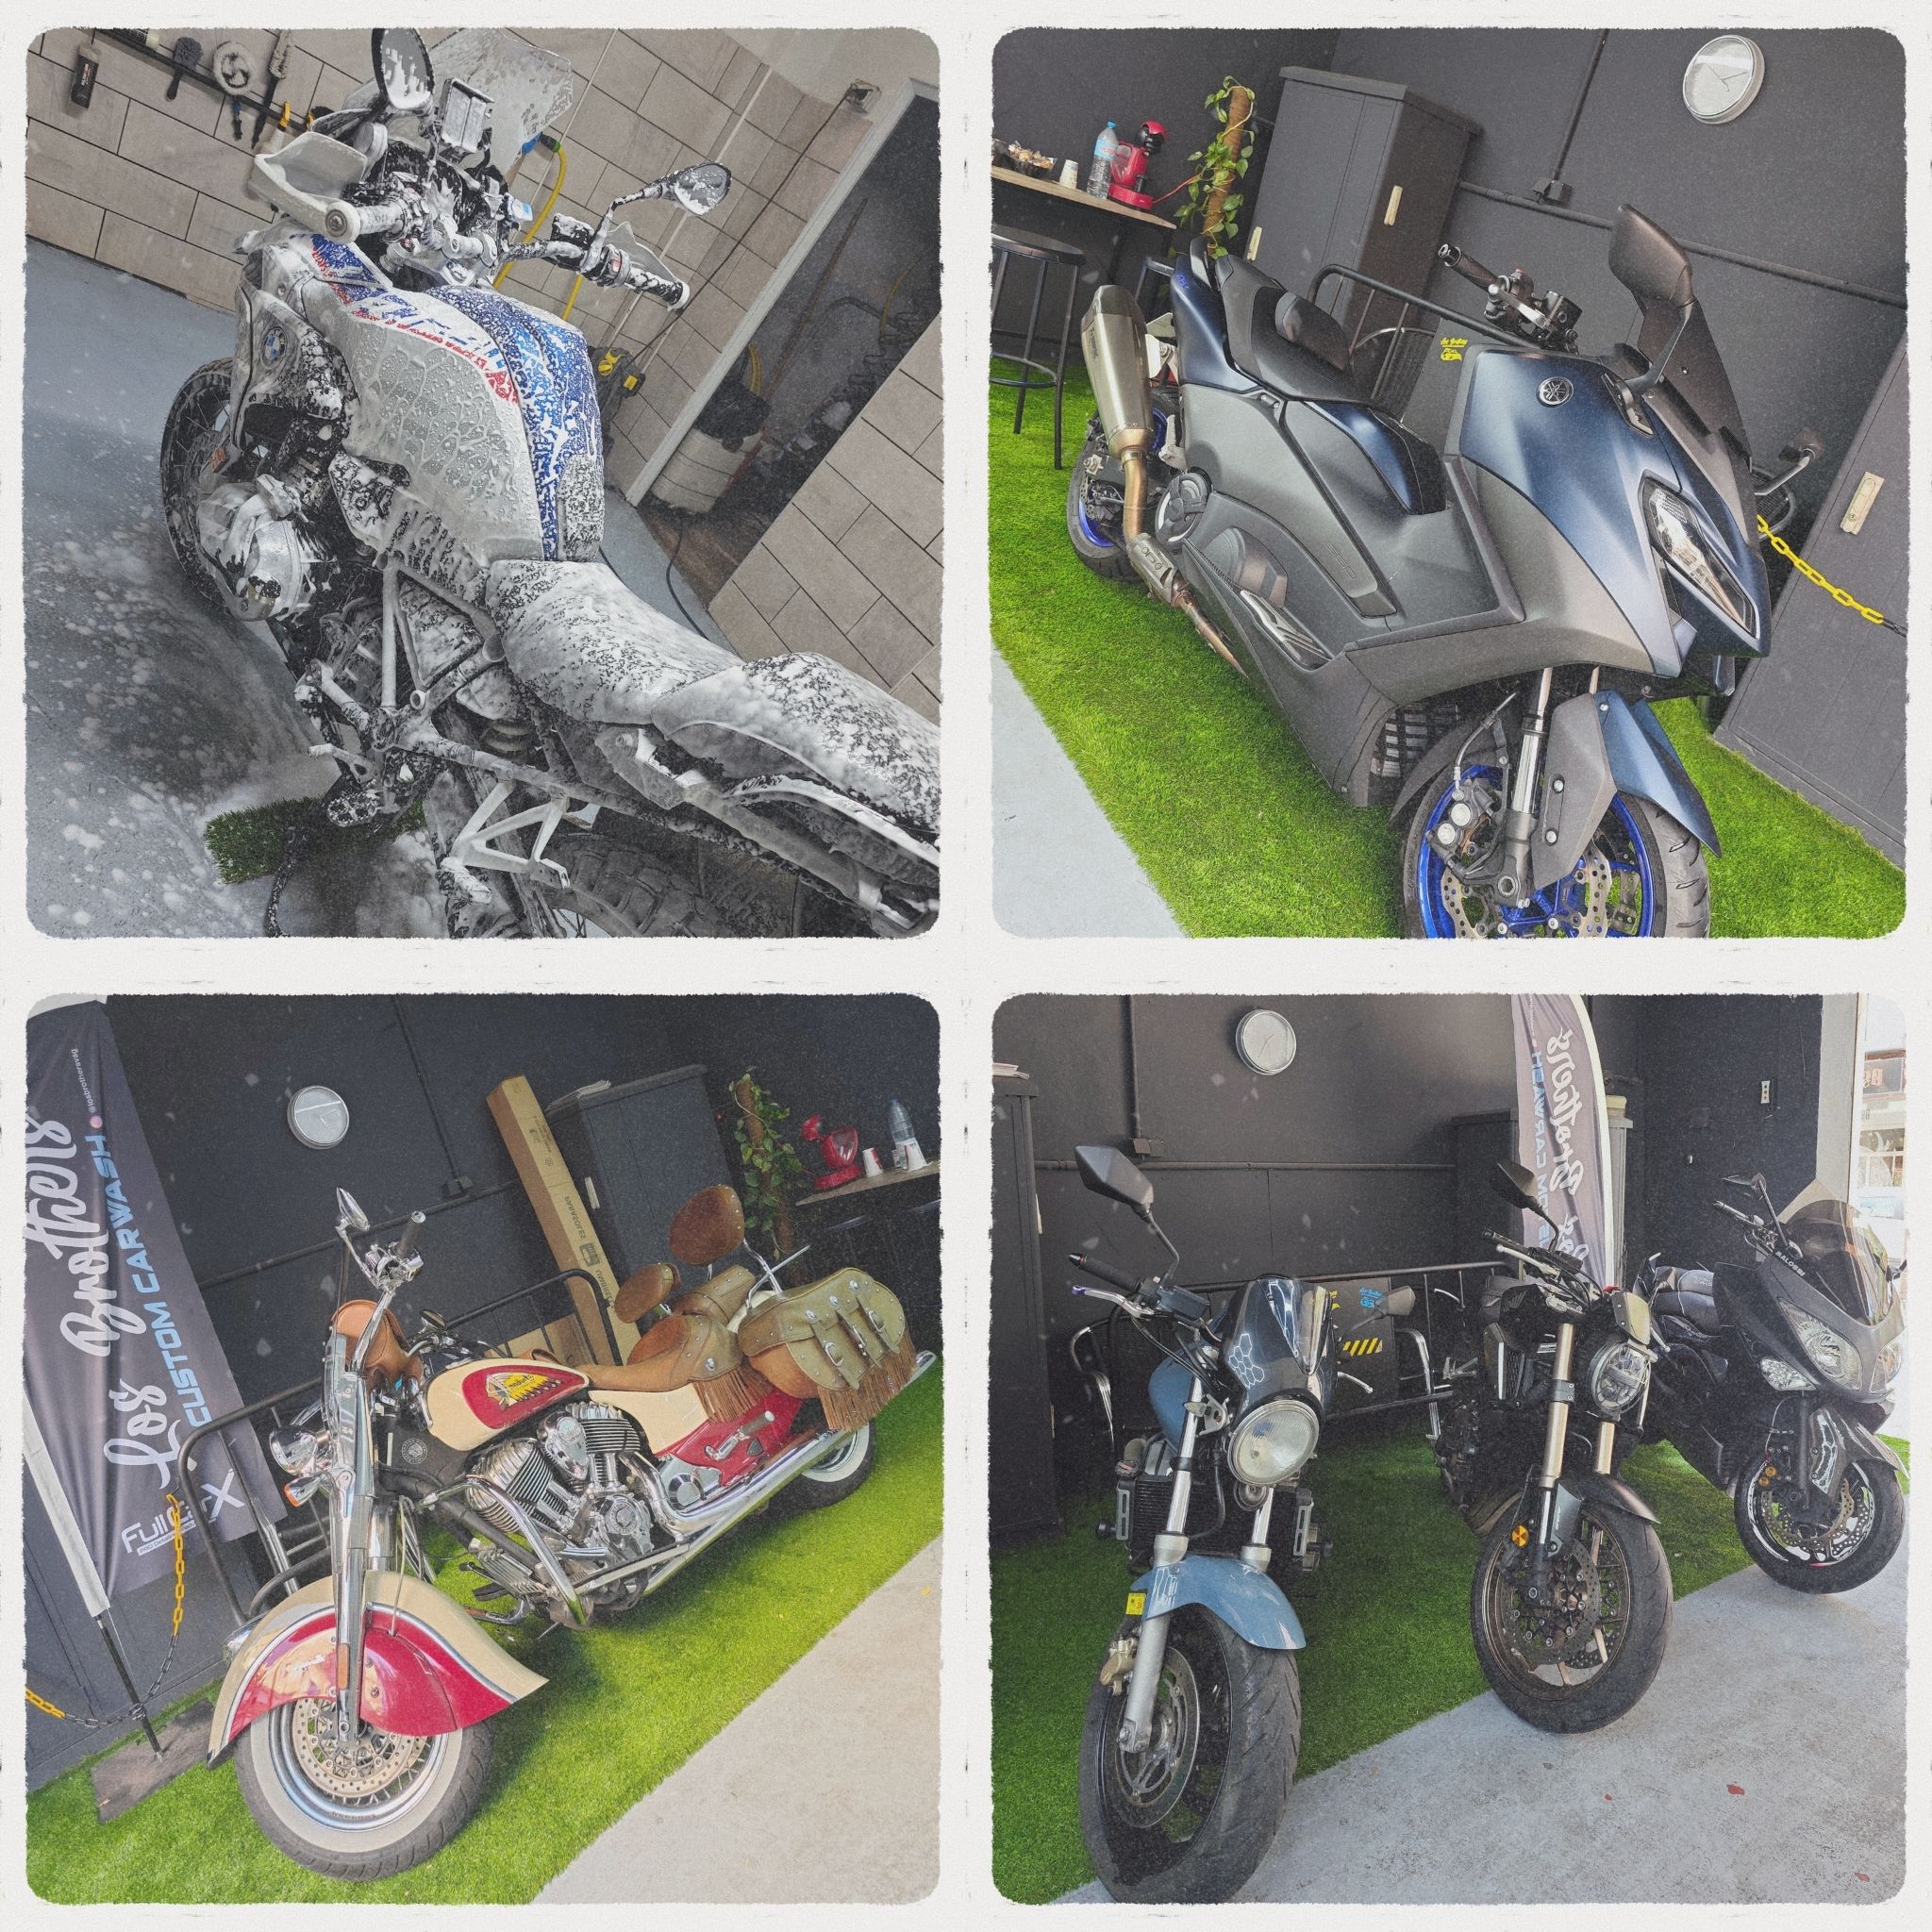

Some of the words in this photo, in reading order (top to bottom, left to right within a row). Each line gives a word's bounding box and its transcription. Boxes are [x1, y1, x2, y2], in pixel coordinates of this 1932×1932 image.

[25, 1116, 147, 1357] Brothers
[85, 1135, 160, 1293] CARWASH
[1774, 1250, 1806, 1276] MALOSSI
[143, 1301, 212, 1427] CUSTOM
[104, 1378, 193, 1489] Los
